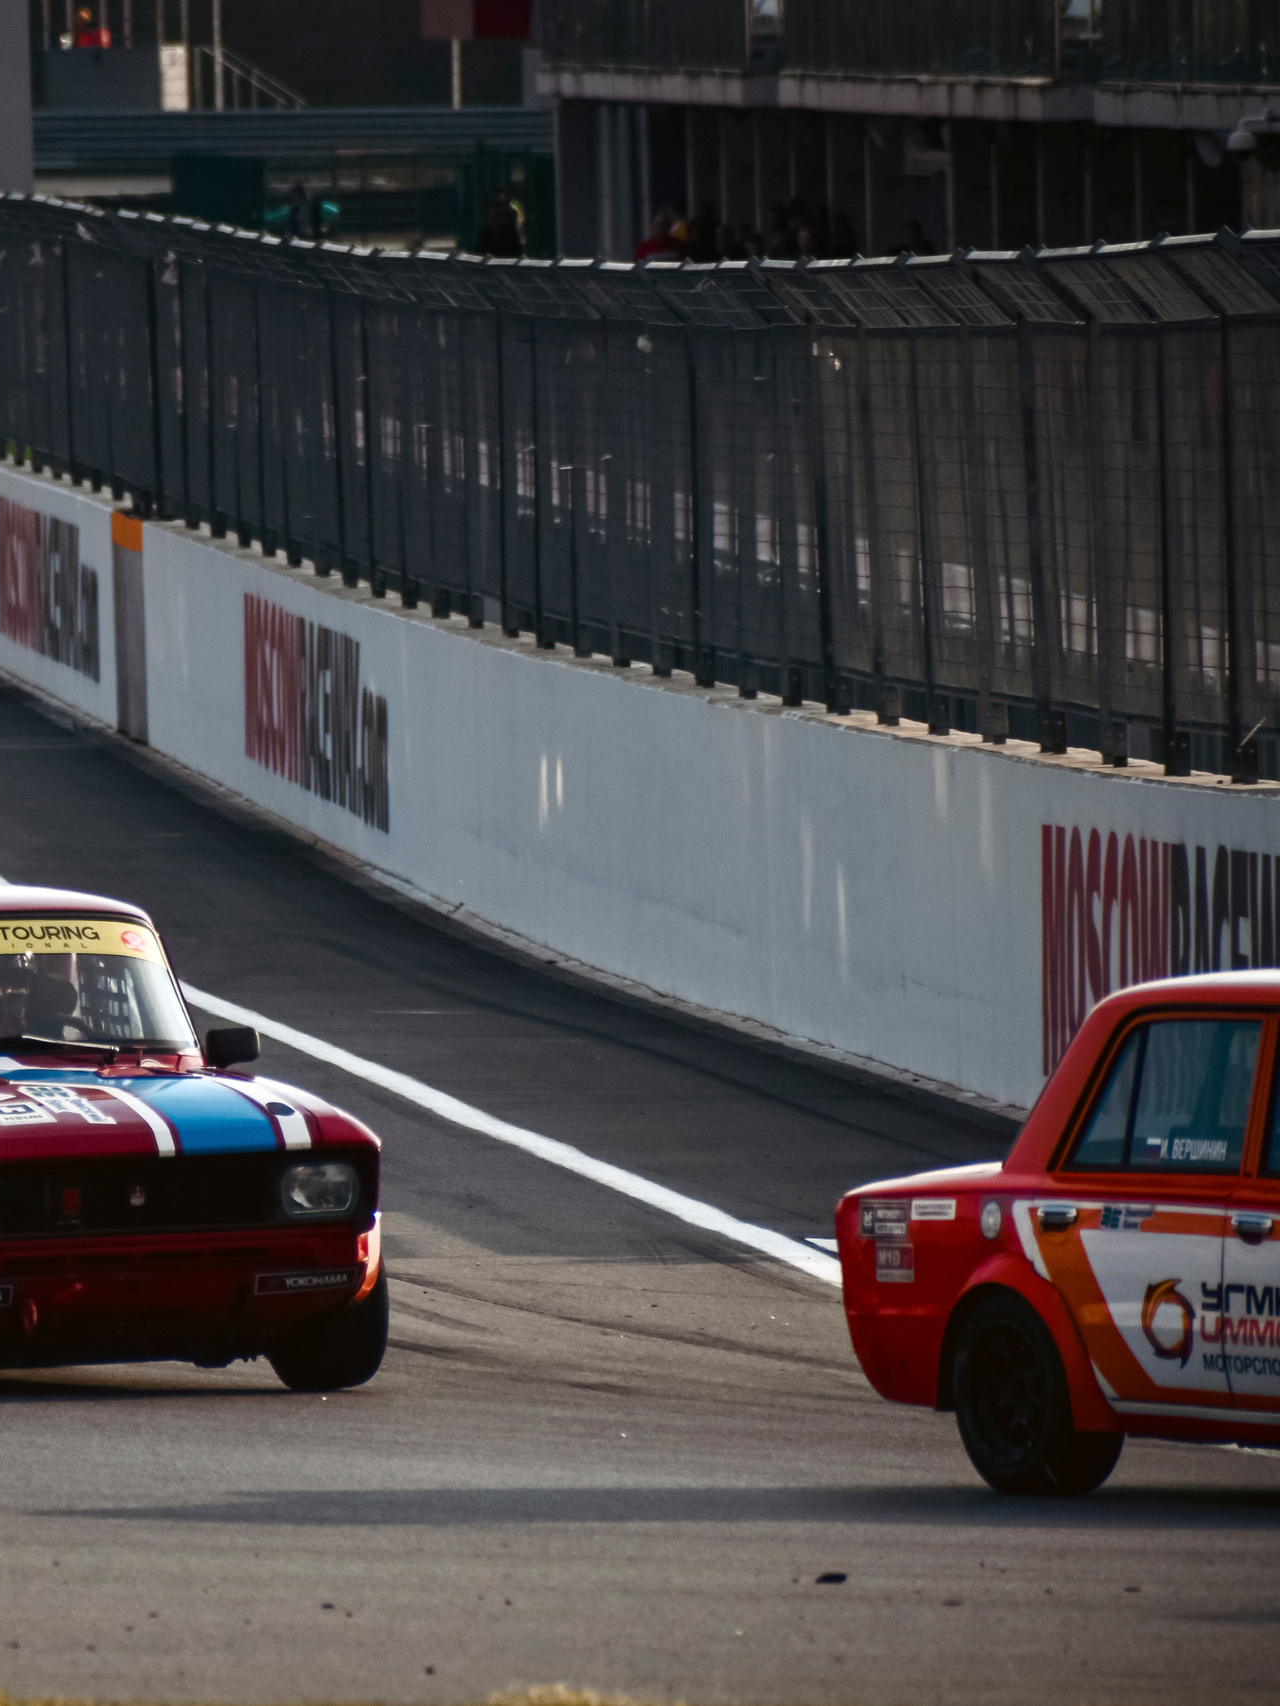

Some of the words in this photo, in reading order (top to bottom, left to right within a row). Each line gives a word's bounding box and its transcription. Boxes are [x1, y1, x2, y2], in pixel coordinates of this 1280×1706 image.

[1172, 1139, 1227, 1161] ВЕРШИНИН
[285, 1273, 348, 1288] YOKOHAMA
[1200, 1315, 1280, 1348] UMM
